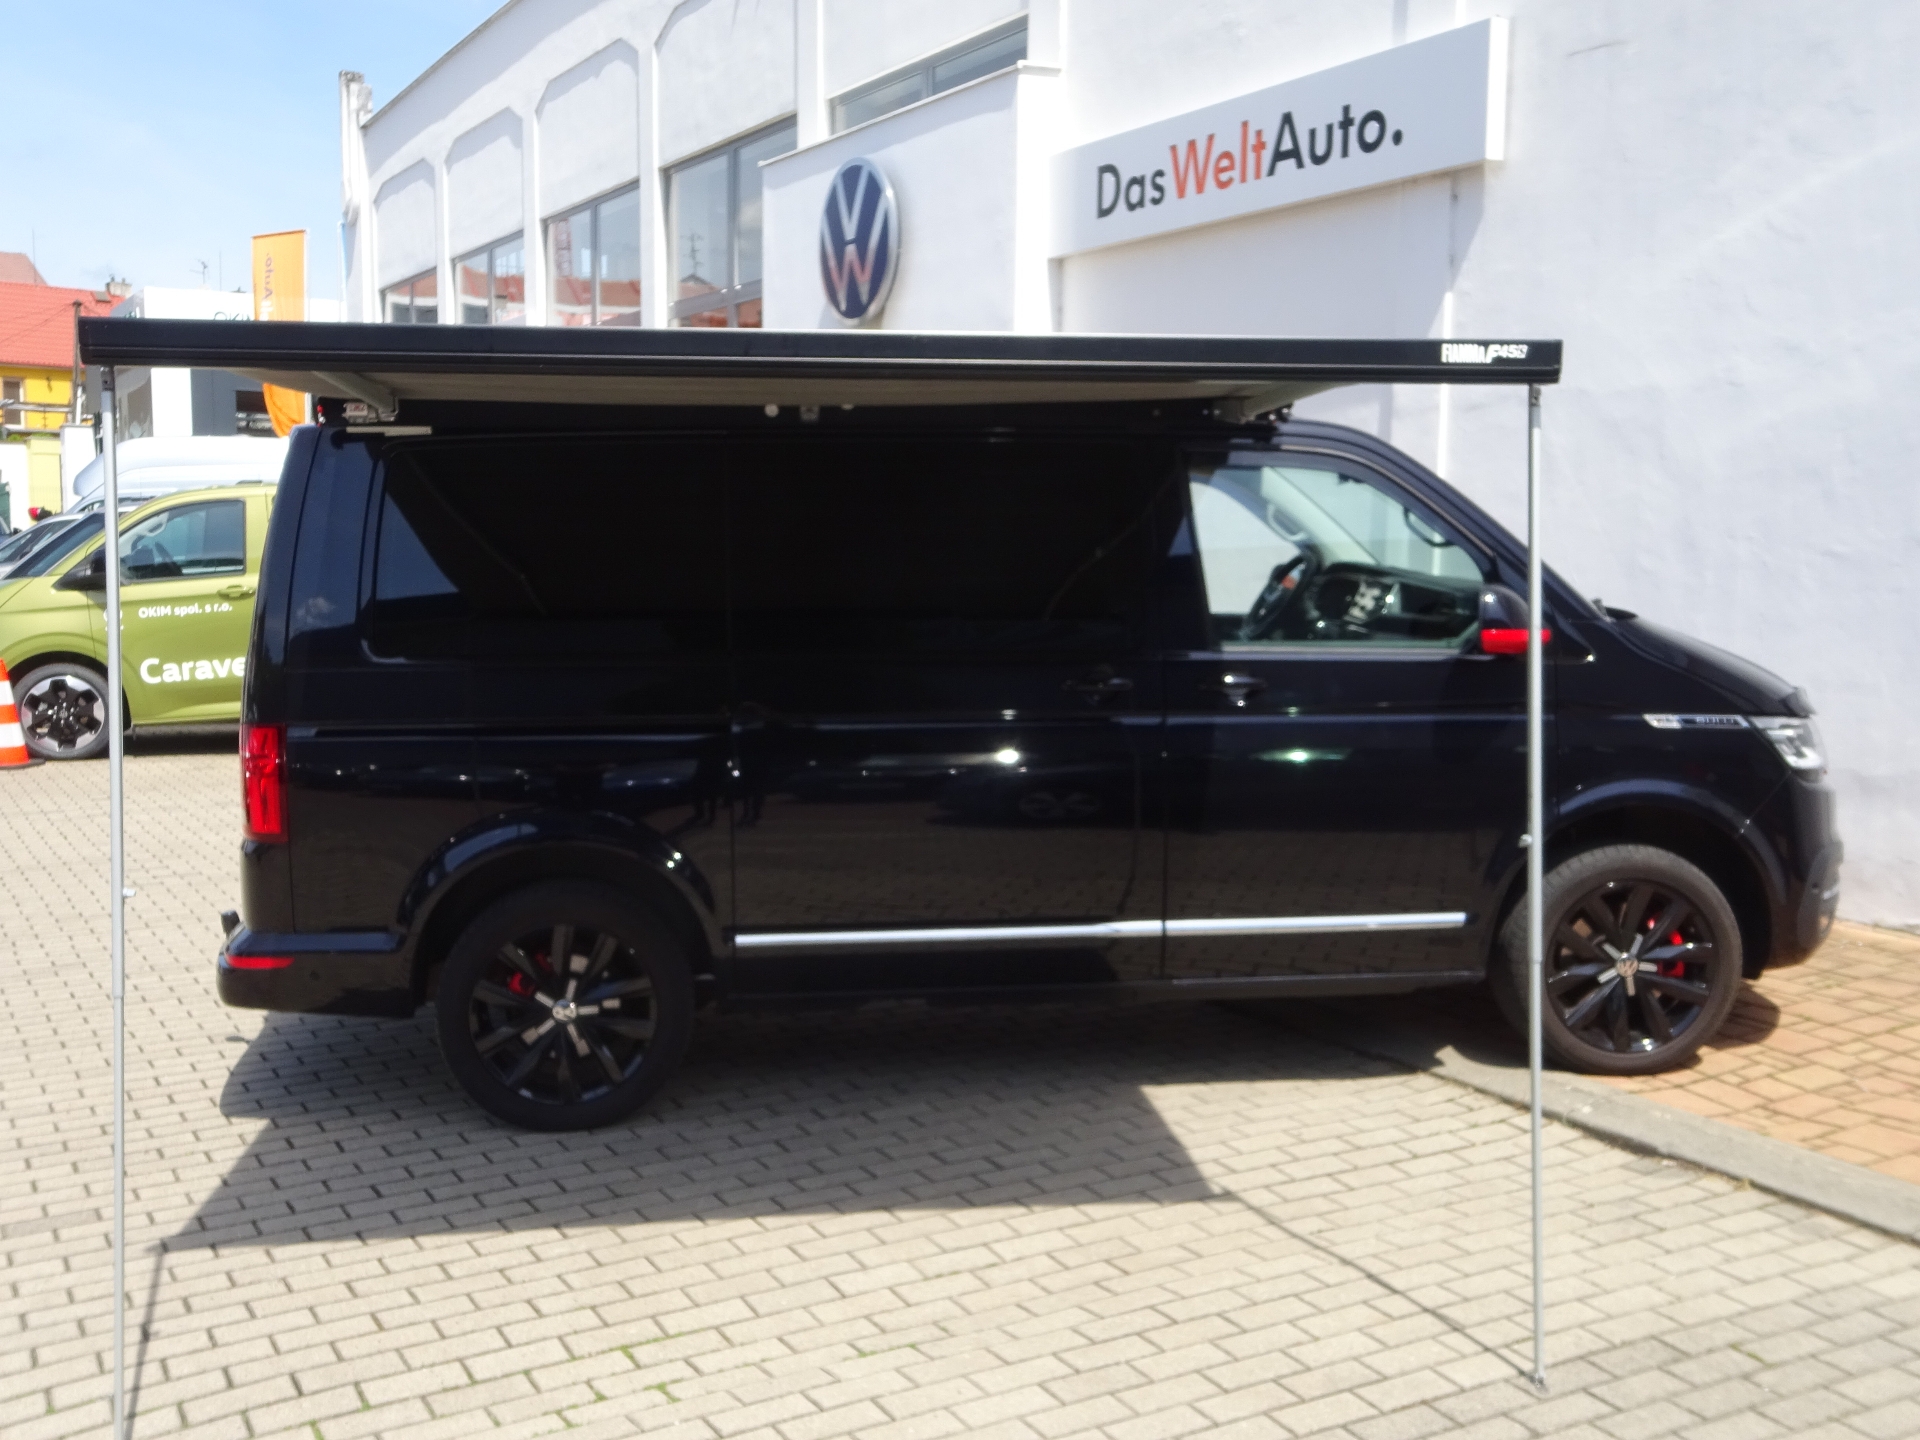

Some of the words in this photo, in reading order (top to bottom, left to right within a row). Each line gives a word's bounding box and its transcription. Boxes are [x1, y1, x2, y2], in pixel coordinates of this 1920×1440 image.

[1097, 103, 1404, 220] DasWeltAuto.
[138, 605, 172, 618] OKIM
[174, 603, 203, 617] spol.
[205, 603, 212, 613] s
[214, 602, 233, 612] r.o.
